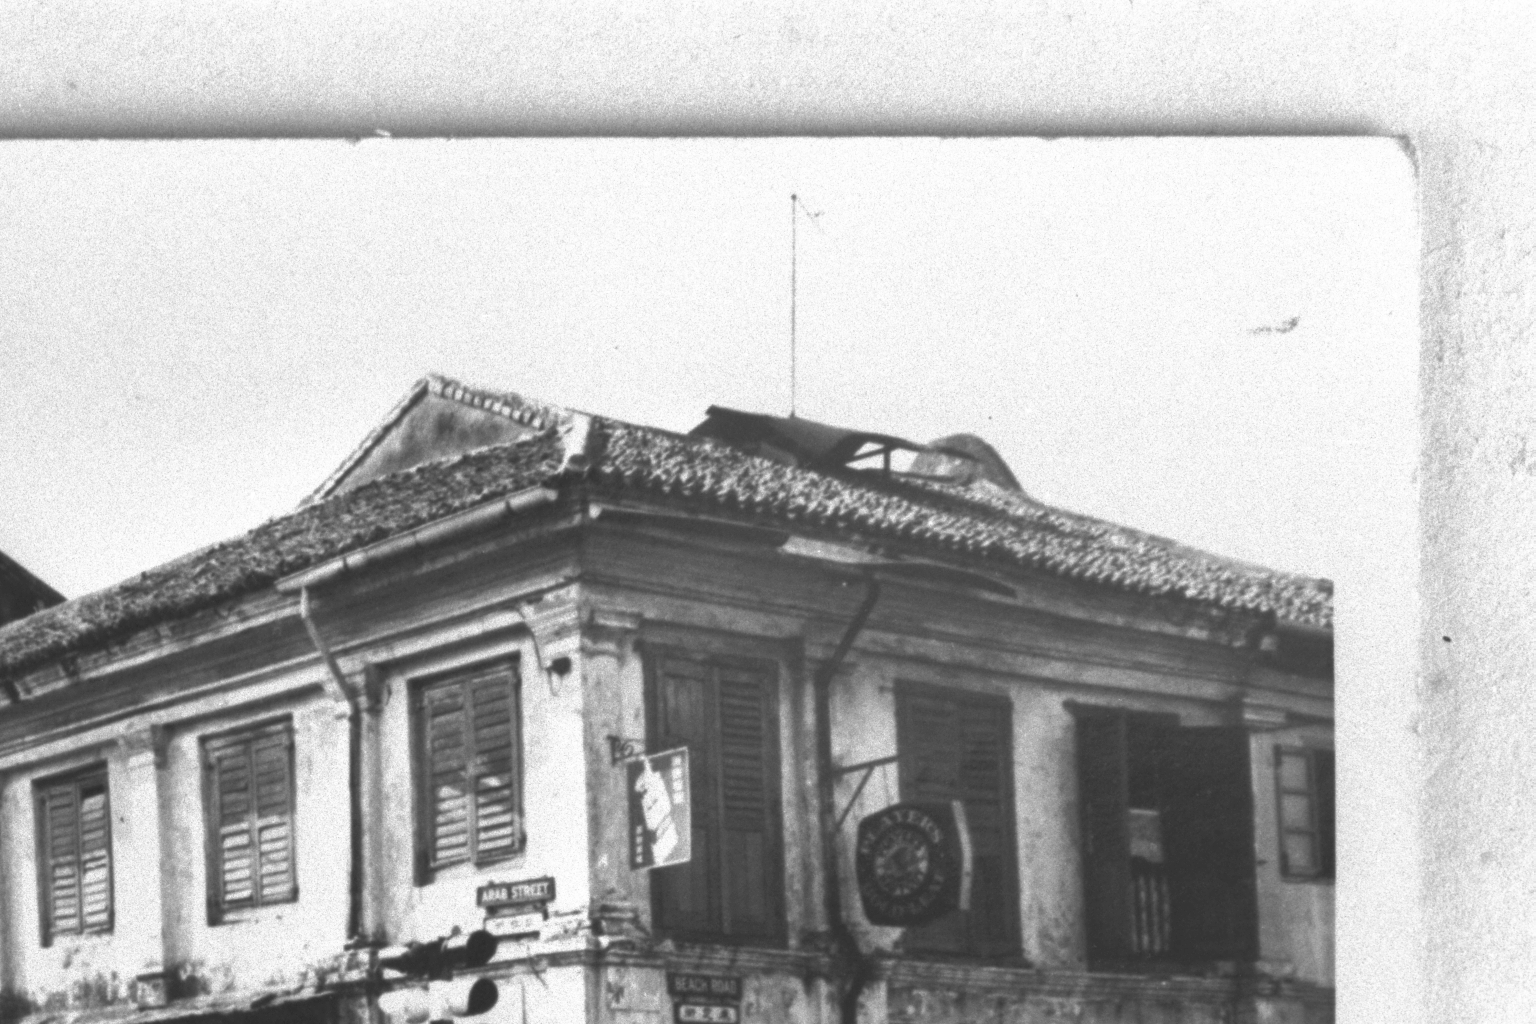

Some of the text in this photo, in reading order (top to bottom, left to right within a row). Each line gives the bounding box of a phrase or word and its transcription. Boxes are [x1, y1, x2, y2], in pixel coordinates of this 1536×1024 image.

[481, 881, 550, 902] ARAB STREET
[674, 976, 737, 995] BEACH ROAD
